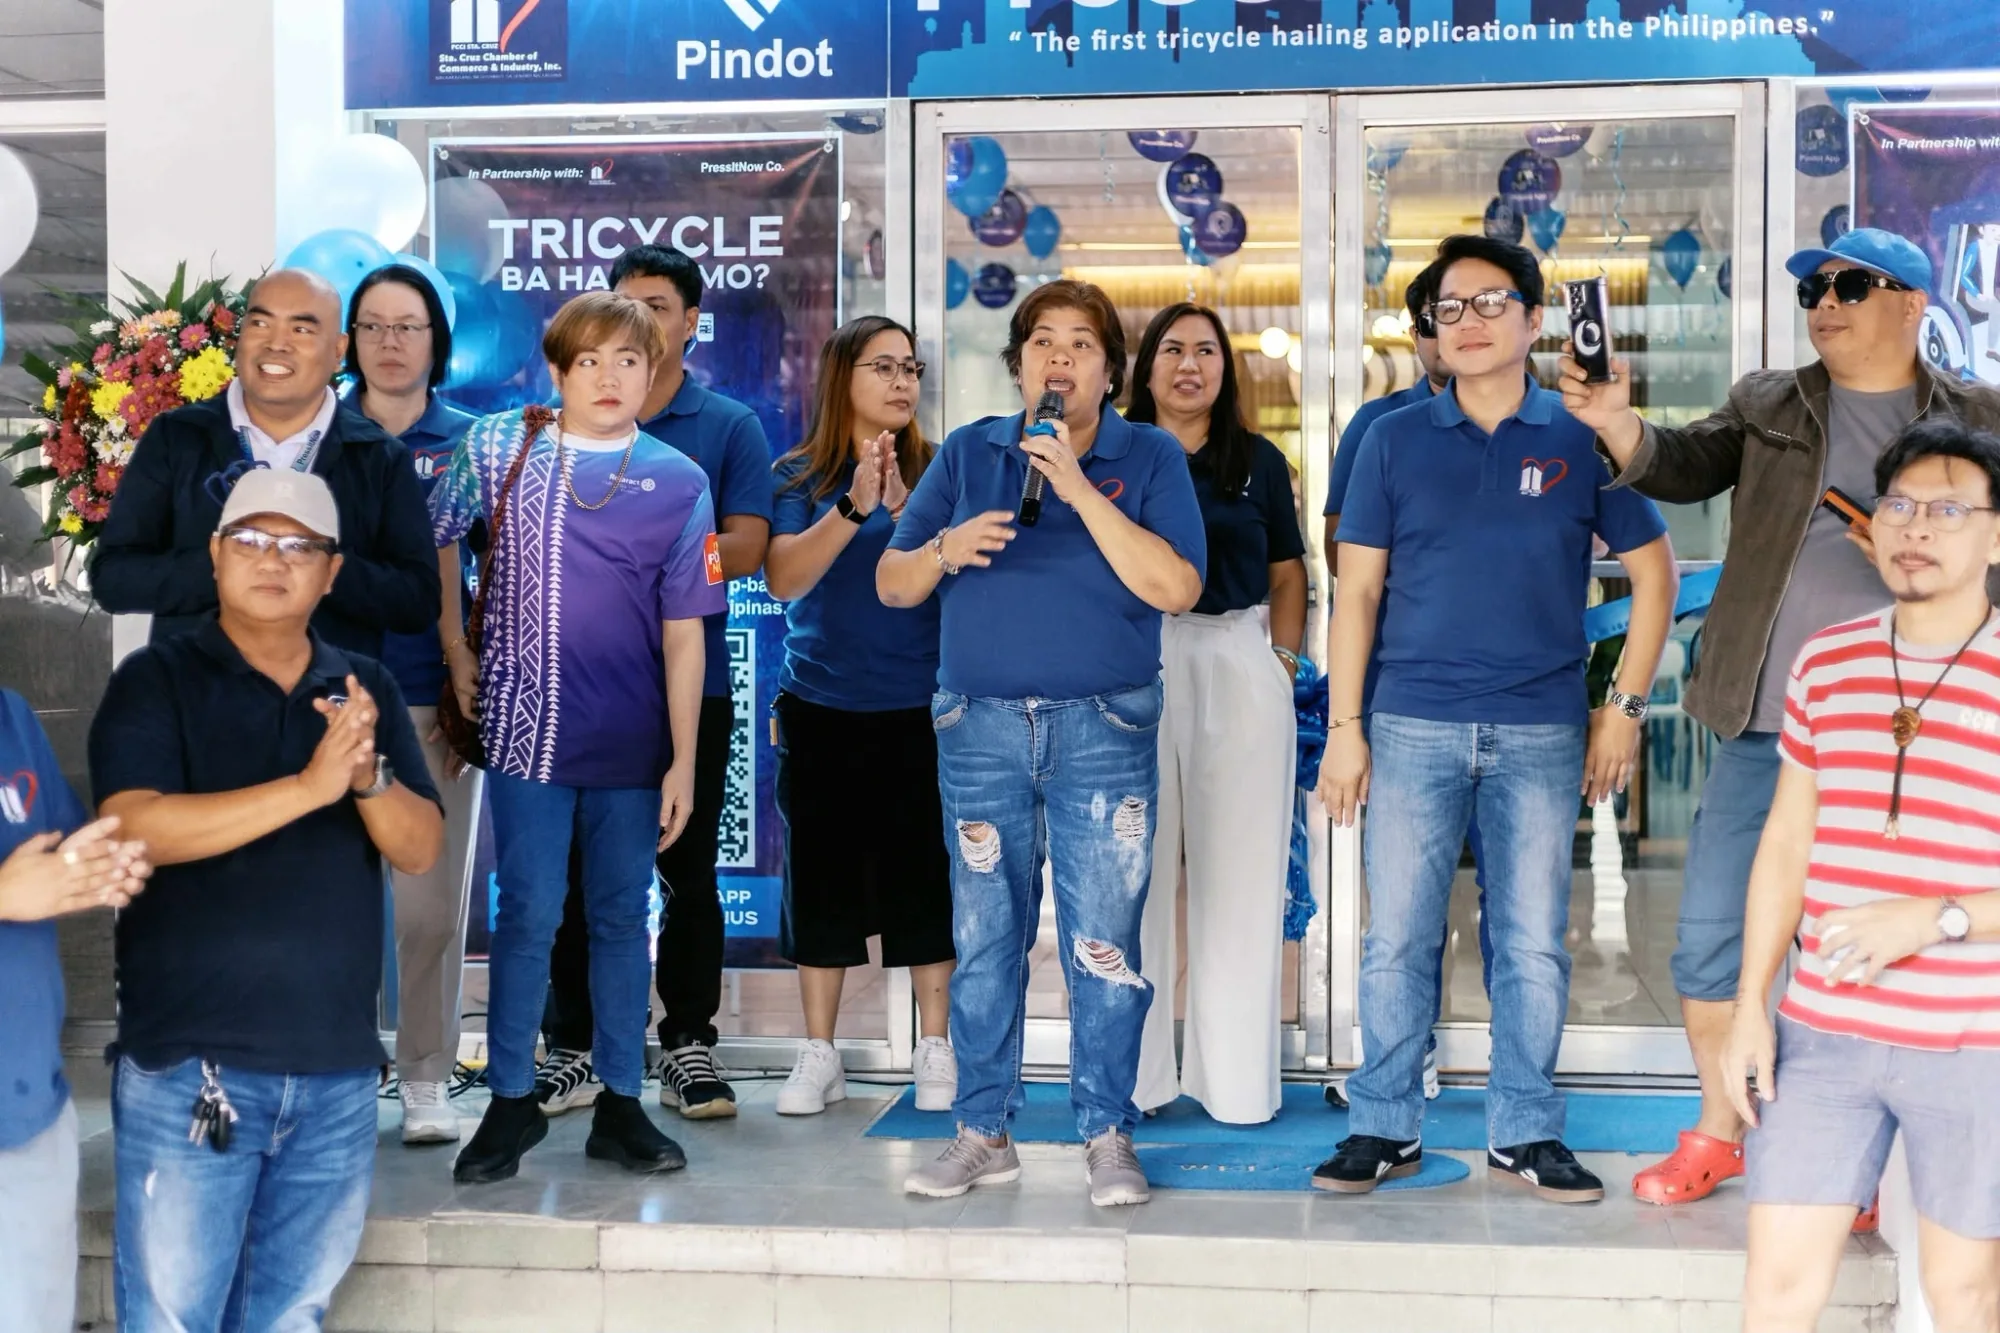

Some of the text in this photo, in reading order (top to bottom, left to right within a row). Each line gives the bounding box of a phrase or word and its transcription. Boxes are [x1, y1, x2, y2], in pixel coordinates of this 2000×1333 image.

[1032, 31, 1081, 52] The
[1091, 29, 1147, 51] first
[1157, 25, 1261, 53] tricycle
[1272, 24, 1368, 49] hailing
[1379, 19, 1537, 48] application
[1549, 18, 1575, 39] in
[1586, 16, 1634, 38] the
[439, 51, 538, 63] Sta. Cruz Chamber of
[676, 38, 834, 80] Pindot
[439, 62, 562, 73] Commerce & Industry, Inc.
[1881, 134, 2000, 151] In Partnership wit
[467, 167, 584, 180] In Partnership with:
[700, 160, 785, 173] PressItNow Co.
[488, 215, 784, 260] TRICYCLE
[502, 266, 550, 291] BA
